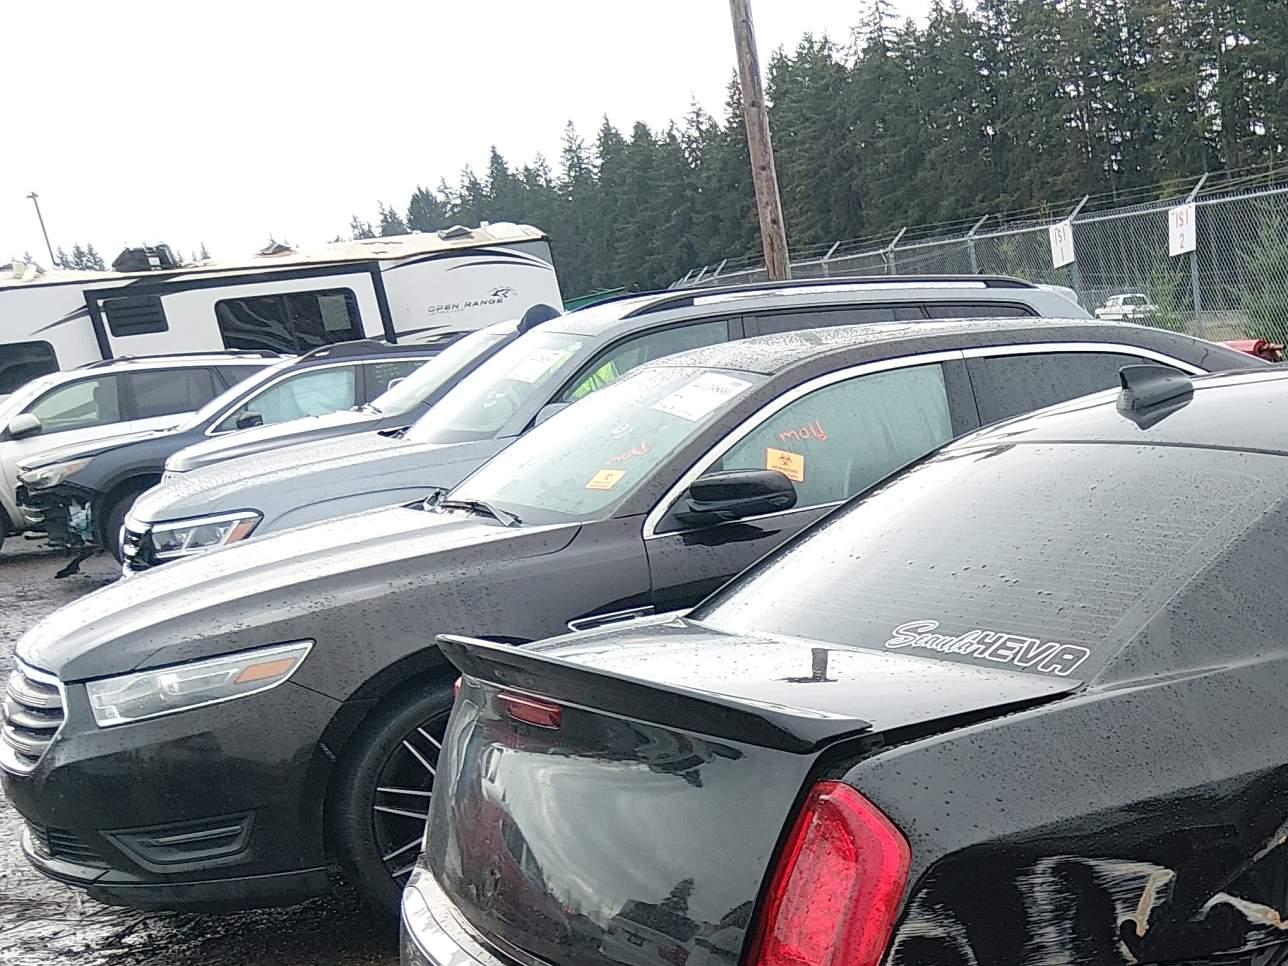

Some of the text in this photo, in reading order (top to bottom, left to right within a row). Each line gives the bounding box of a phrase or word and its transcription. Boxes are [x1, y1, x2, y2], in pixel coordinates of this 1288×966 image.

[1179, 233, 1185, 249] 2
[427, 303, 460, 313] OPEN
[464, 298, 504, 308] RANGE
